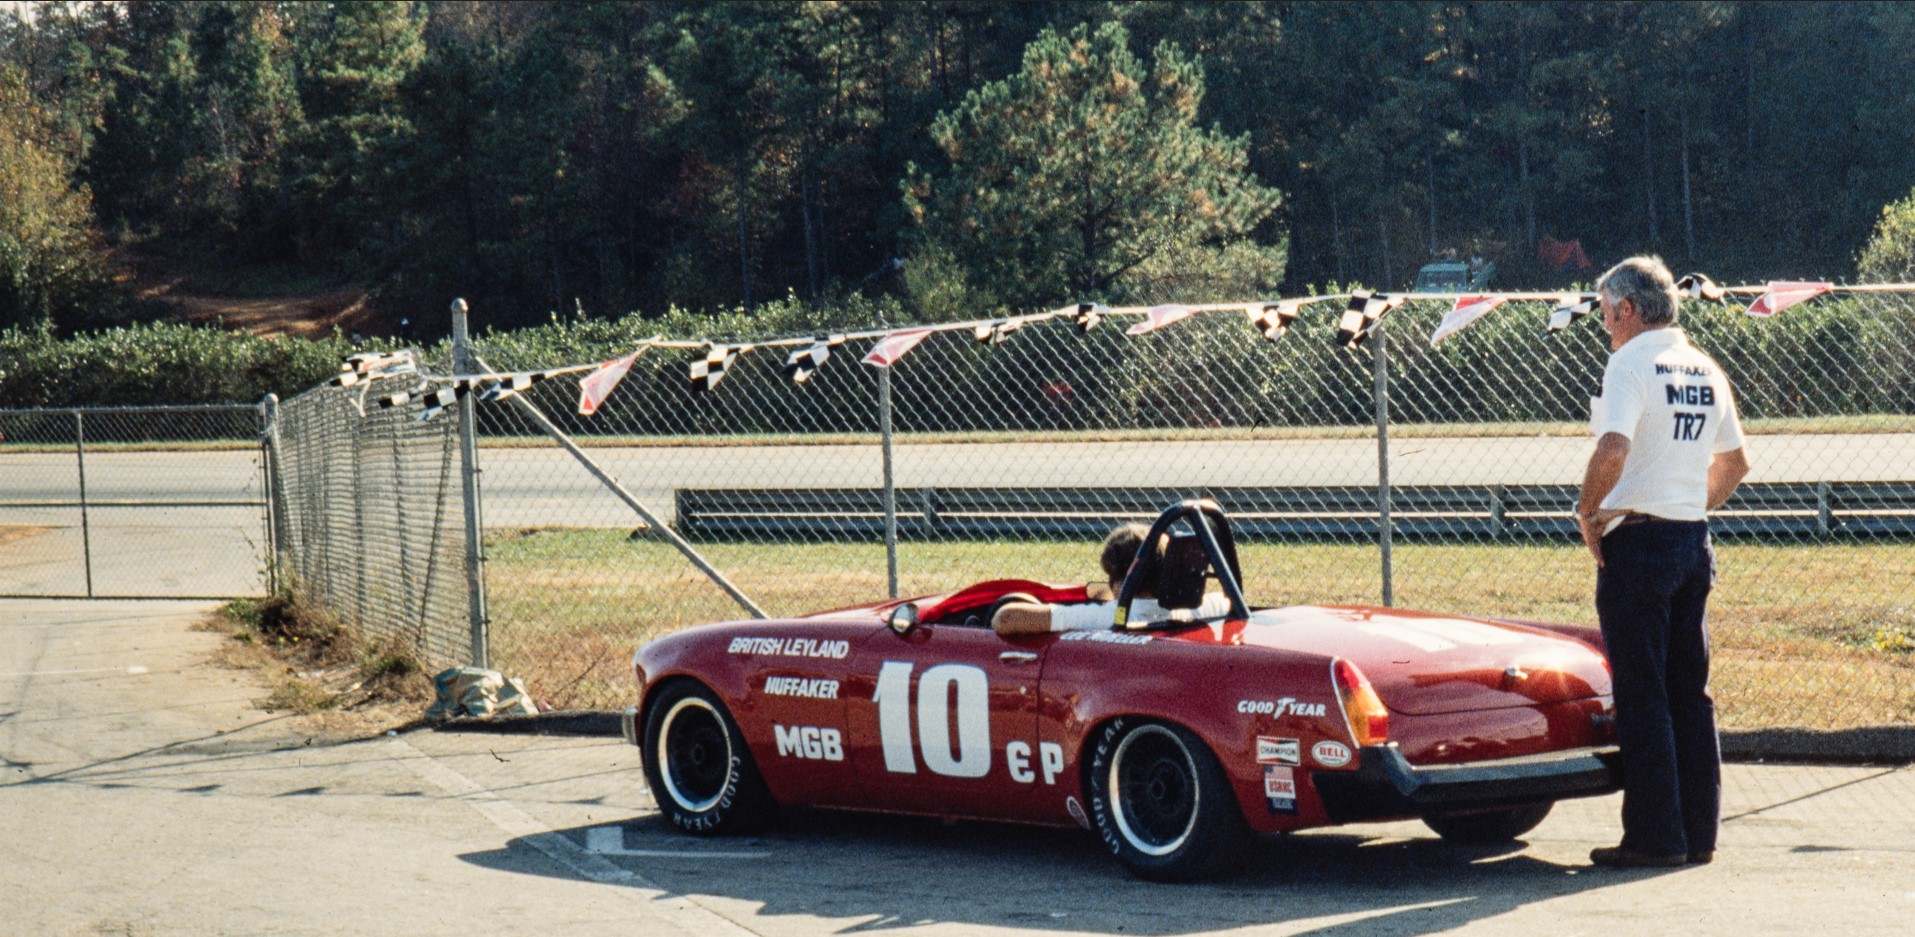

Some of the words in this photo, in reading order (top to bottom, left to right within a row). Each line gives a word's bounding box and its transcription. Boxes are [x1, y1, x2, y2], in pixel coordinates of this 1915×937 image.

[1665, 384, 1715, 406] MGB
[1673, 412, 1706, 441] TR7
[727, 637, 783, 655] BRITISH
[784, 638, 849, 659] LEYLAND
[764, 676, 840, 699] HUFFAKER
[872, 661, 991, 778] 10
[774, 724, 844, 761] MGB
[1260, 746, 1296, 757] CHAMPION
[1319, 747, 1346, 757] BELL
